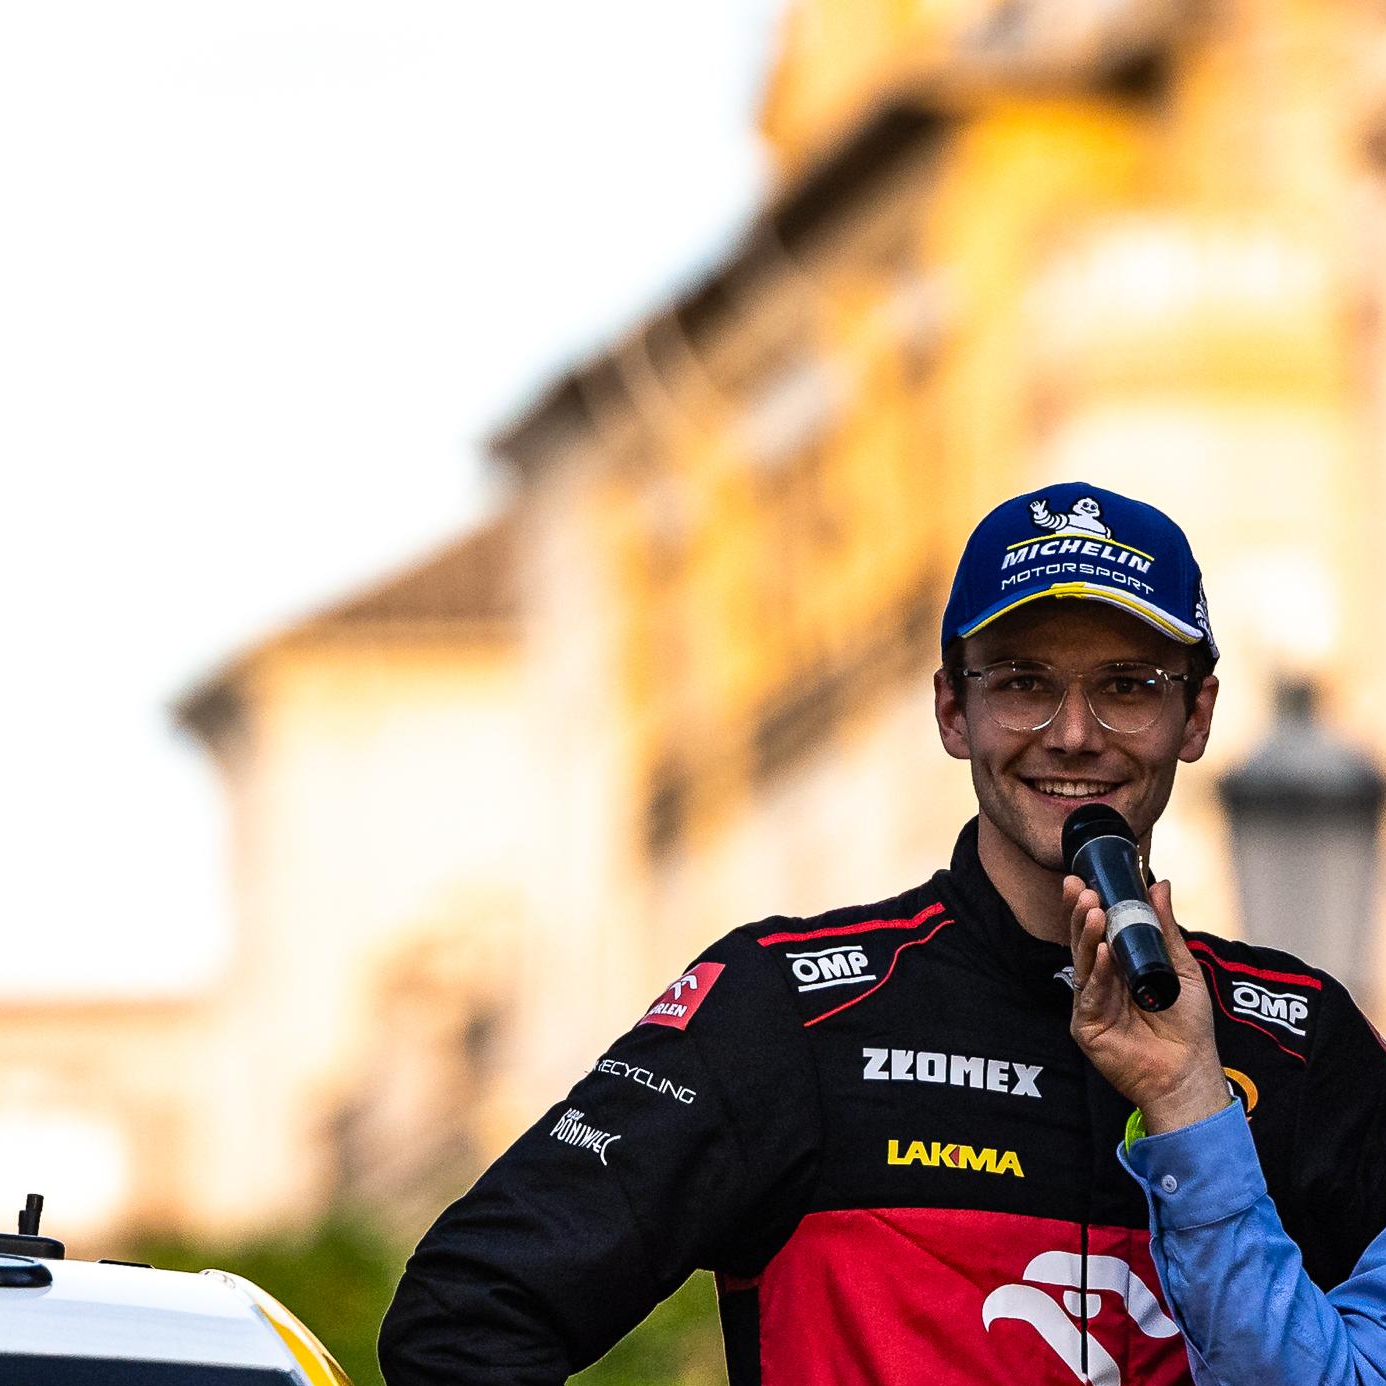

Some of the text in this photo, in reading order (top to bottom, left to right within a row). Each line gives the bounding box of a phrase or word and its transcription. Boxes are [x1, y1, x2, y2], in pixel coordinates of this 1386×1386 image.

[1001, 539, 1154, 574] MICHELIN
[1001, 562, 1154, 596] MOTORSPORT
[792, 946, 870, 984] OMP
[1233, 986, 1308, 1024] OMP
[887, 1139, 1025, 1178] LAKMA
